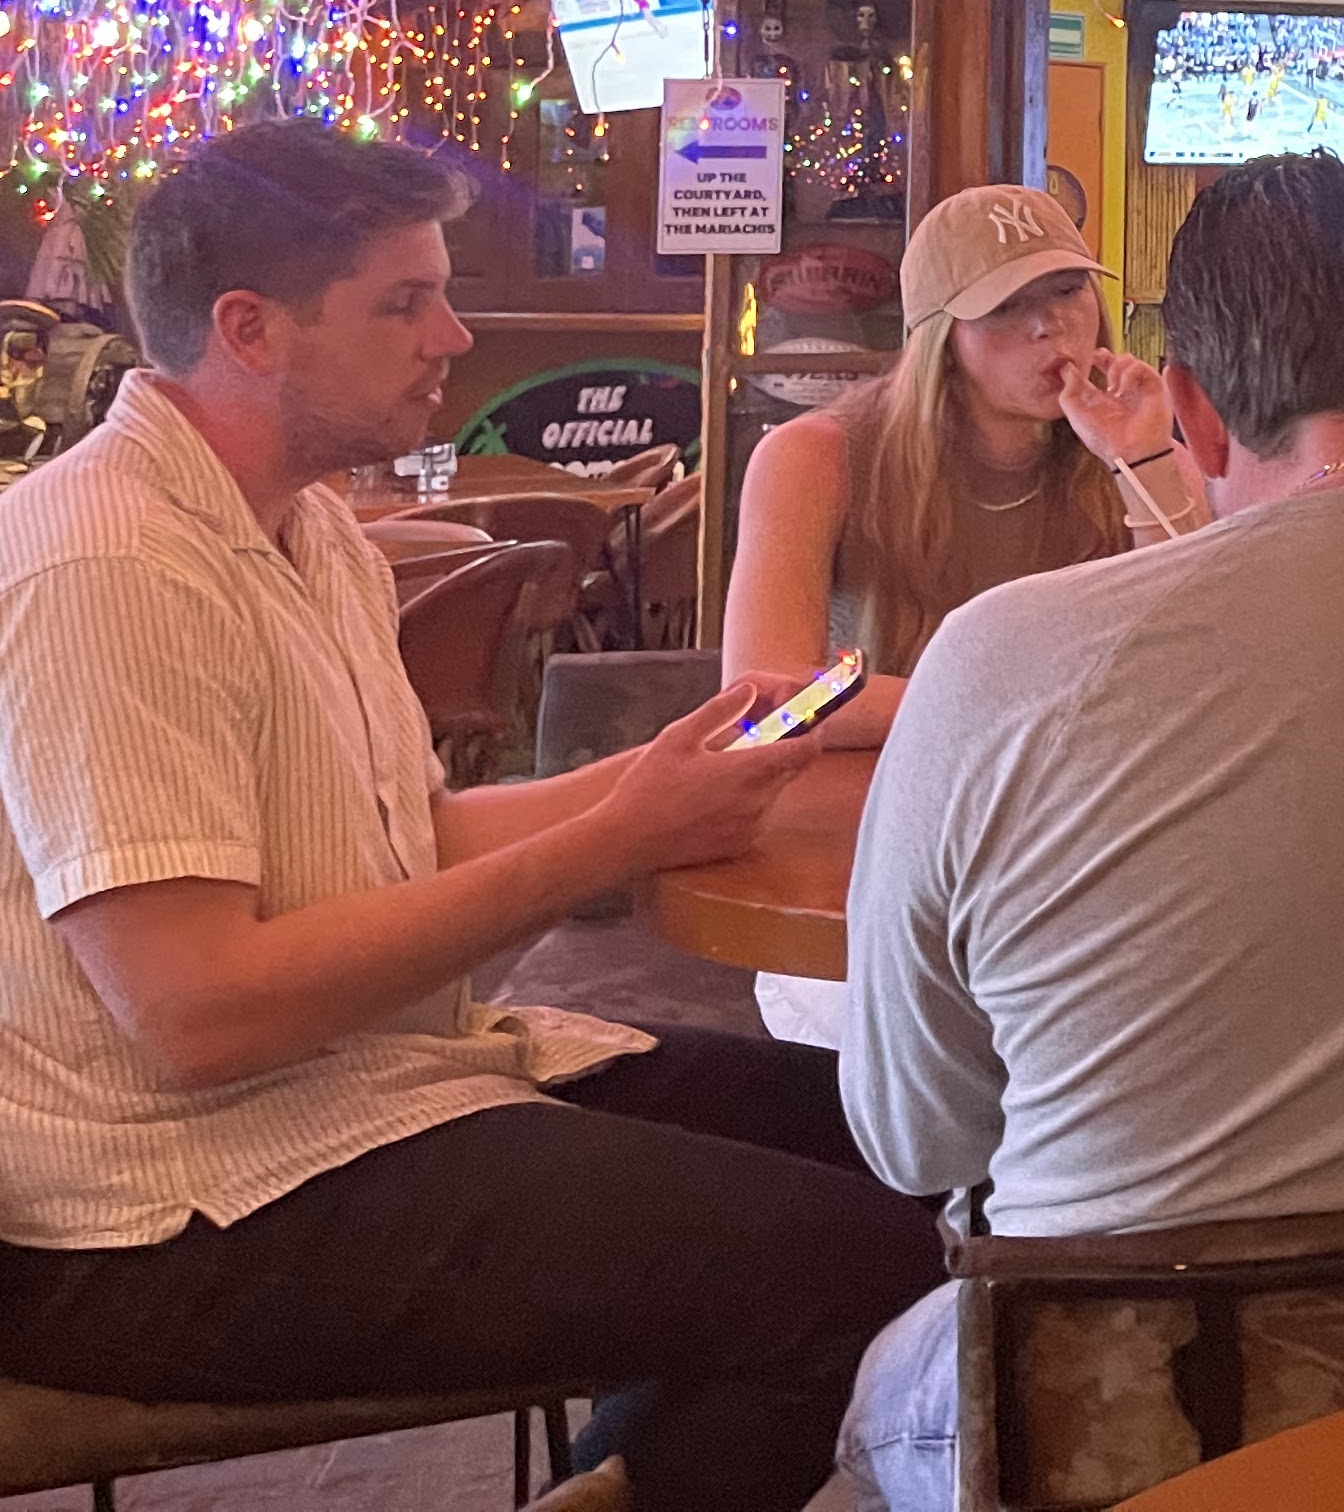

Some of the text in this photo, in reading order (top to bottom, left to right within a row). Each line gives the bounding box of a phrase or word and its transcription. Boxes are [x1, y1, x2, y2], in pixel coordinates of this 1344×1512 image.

[697, 172, 747, 184] UP THE
[673, 189, 767, 202] COURTYARD,
[672, 207, 770, 218] THEN LEFT AT
[988, 198, 1044, 244] NY
[664, 223, 776, 235] THE MARIACHIS
[577, 385, 628, 415] THE
[541, 417, 654, 450] OFFICIAL
